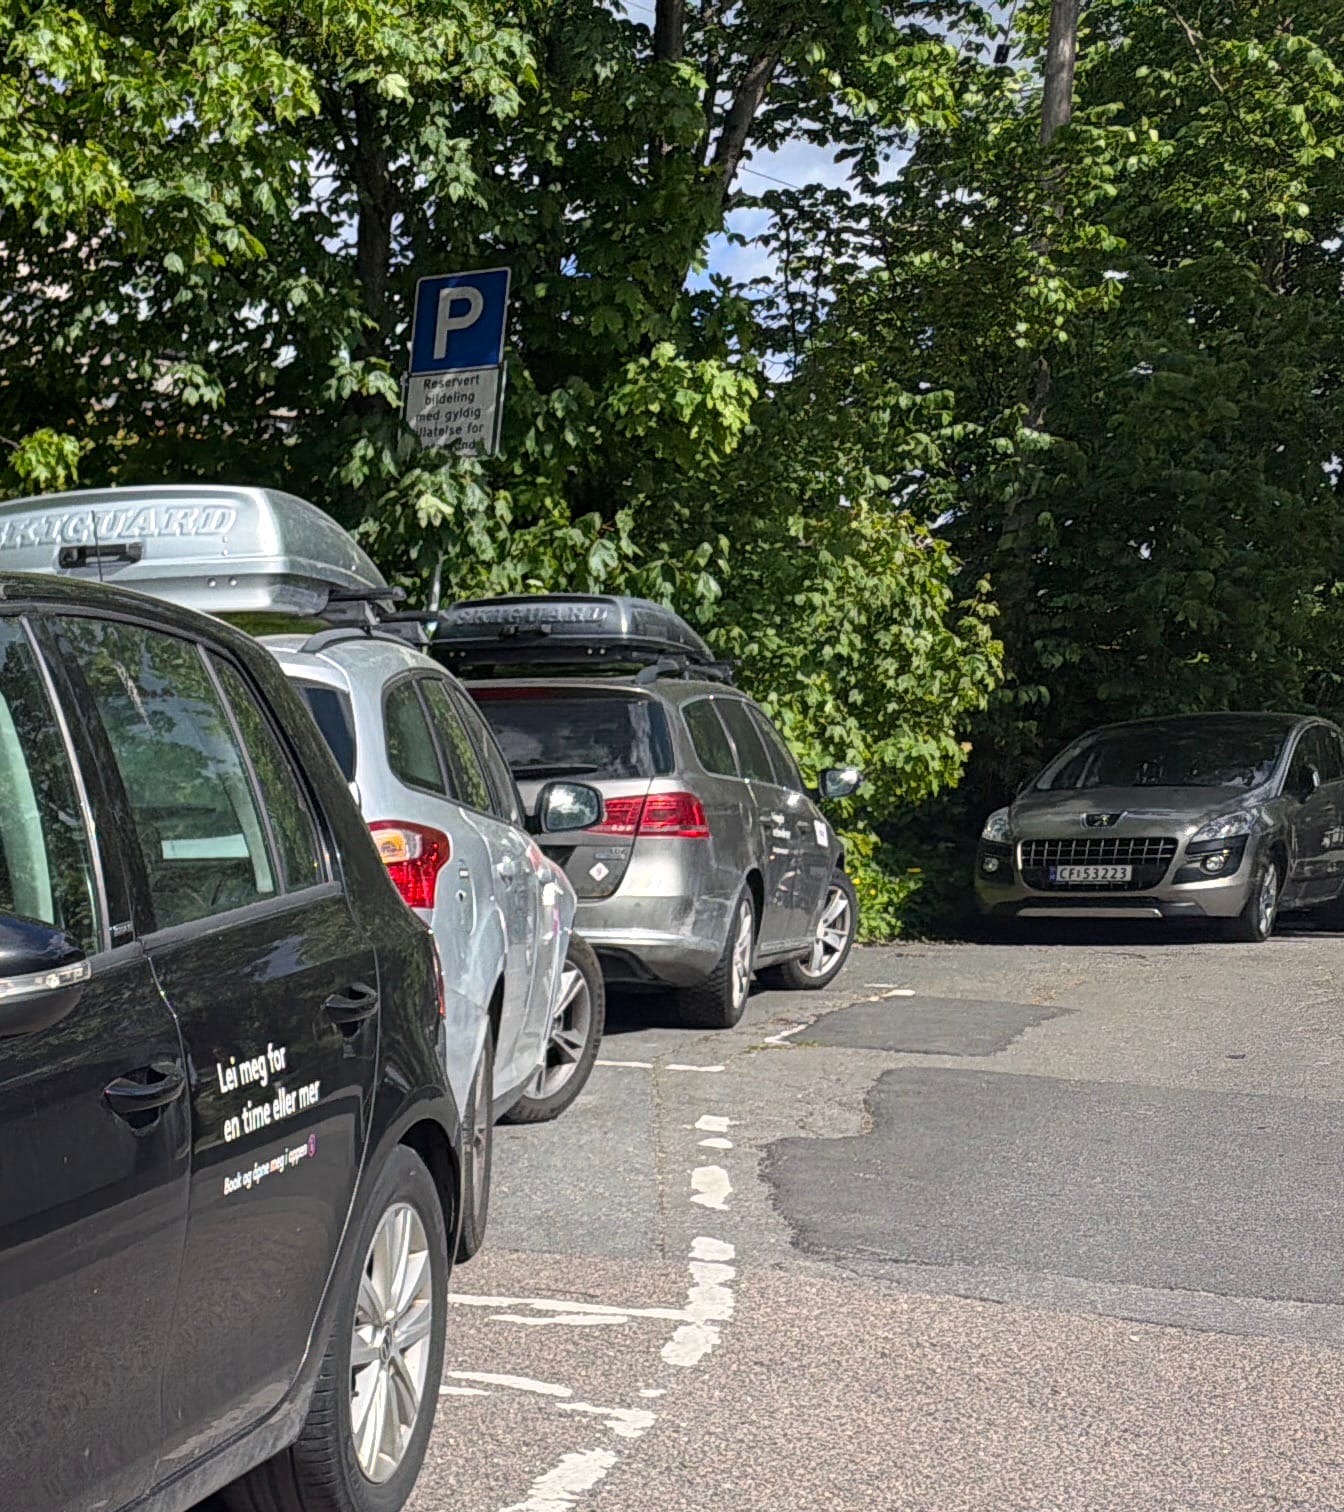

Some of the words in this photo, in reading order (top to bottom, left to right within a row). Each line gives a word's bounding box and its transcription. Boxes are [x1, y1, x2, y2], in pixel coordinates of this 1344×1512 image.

[433, 286, 484, 360] P
[423, 374, 480, 390] Reservert
[424, 391, 475, 406] bildeling
[416, 409, 440, 422] med
[444, 407, 481, 423] gyldig
[467, 422, 484, 435] for
[1059, 867, 1076, 880] CF
[1082, 867, 1127, 880] 53223
[216, 1055, 239, 1094] Lei
[239, 1053, 269, 1088] meg
[267, 1042, 287, 1074] for
[223, 1115, 241, 1143] en
[241, 1100, 271, 1135] time
[272, 1086, 298, 1121] eller
[298, 1079, 321, 1109] mer
[223, 1171, 242, 1196] Book
[242, 1170, 253, 1190] og
[270, 1154, 285, 1174] meg
[288, 1143, 308, 1168] appen
